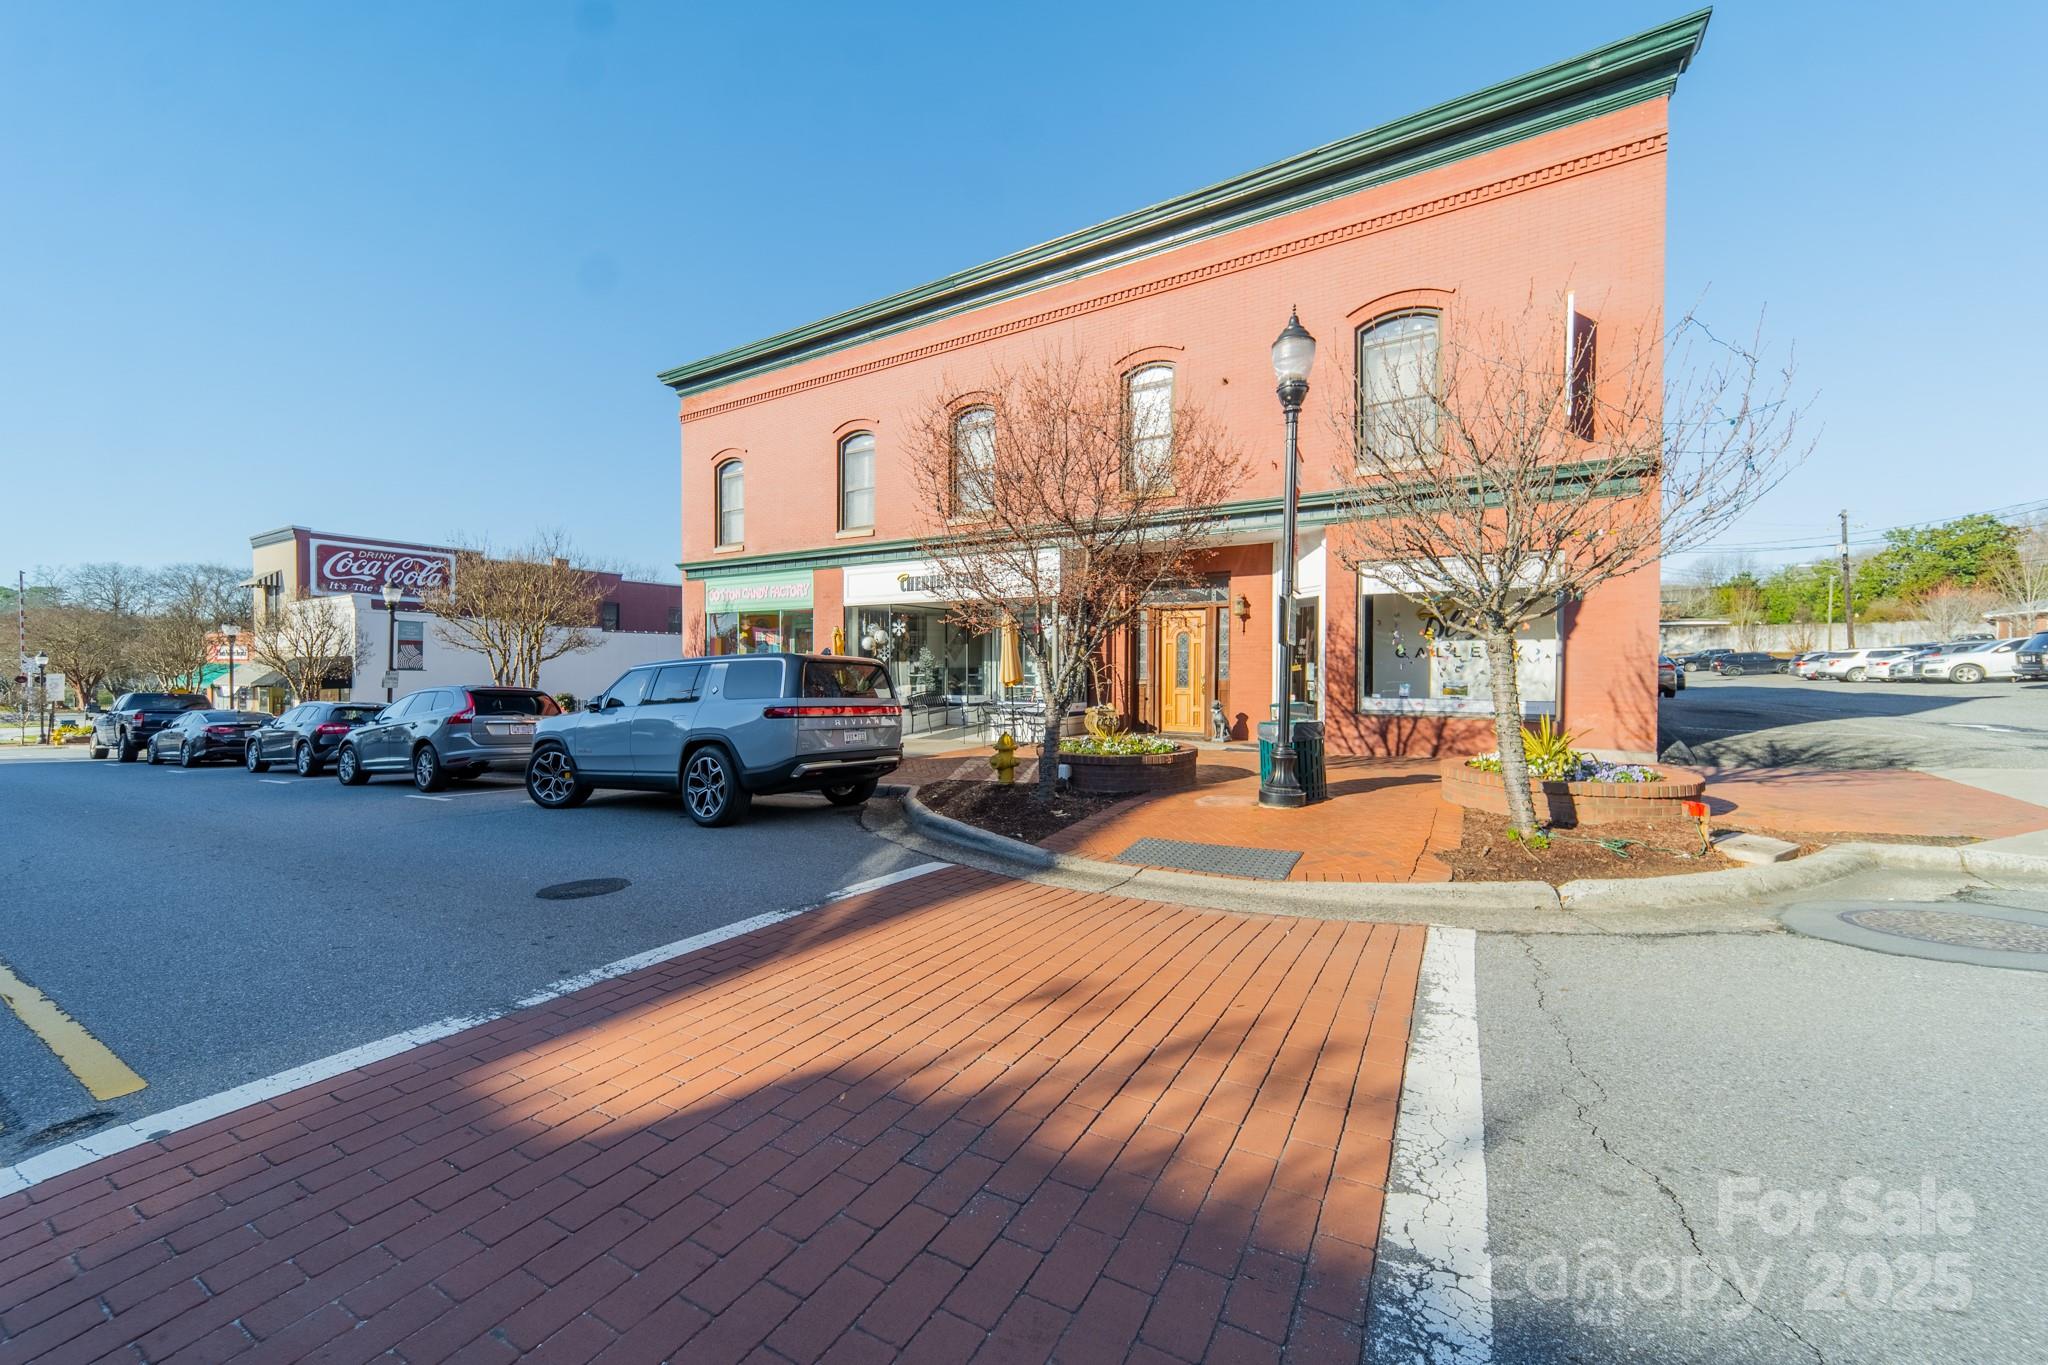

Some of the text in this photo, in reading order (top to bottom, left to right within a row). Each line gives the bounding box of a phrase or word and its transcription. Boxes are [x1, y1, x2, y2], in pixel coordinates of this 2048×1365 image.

[358, 550, 396, 561] DRINK
[322, 550, 445, 587] Coca-Cola
[328, 581, 348, 591] It's
[353, 582, 374, 592] The
[709, 582, 810, 602] COTTON CANDY FACTORY
[834, 718, 880, 726] RIVIAN
